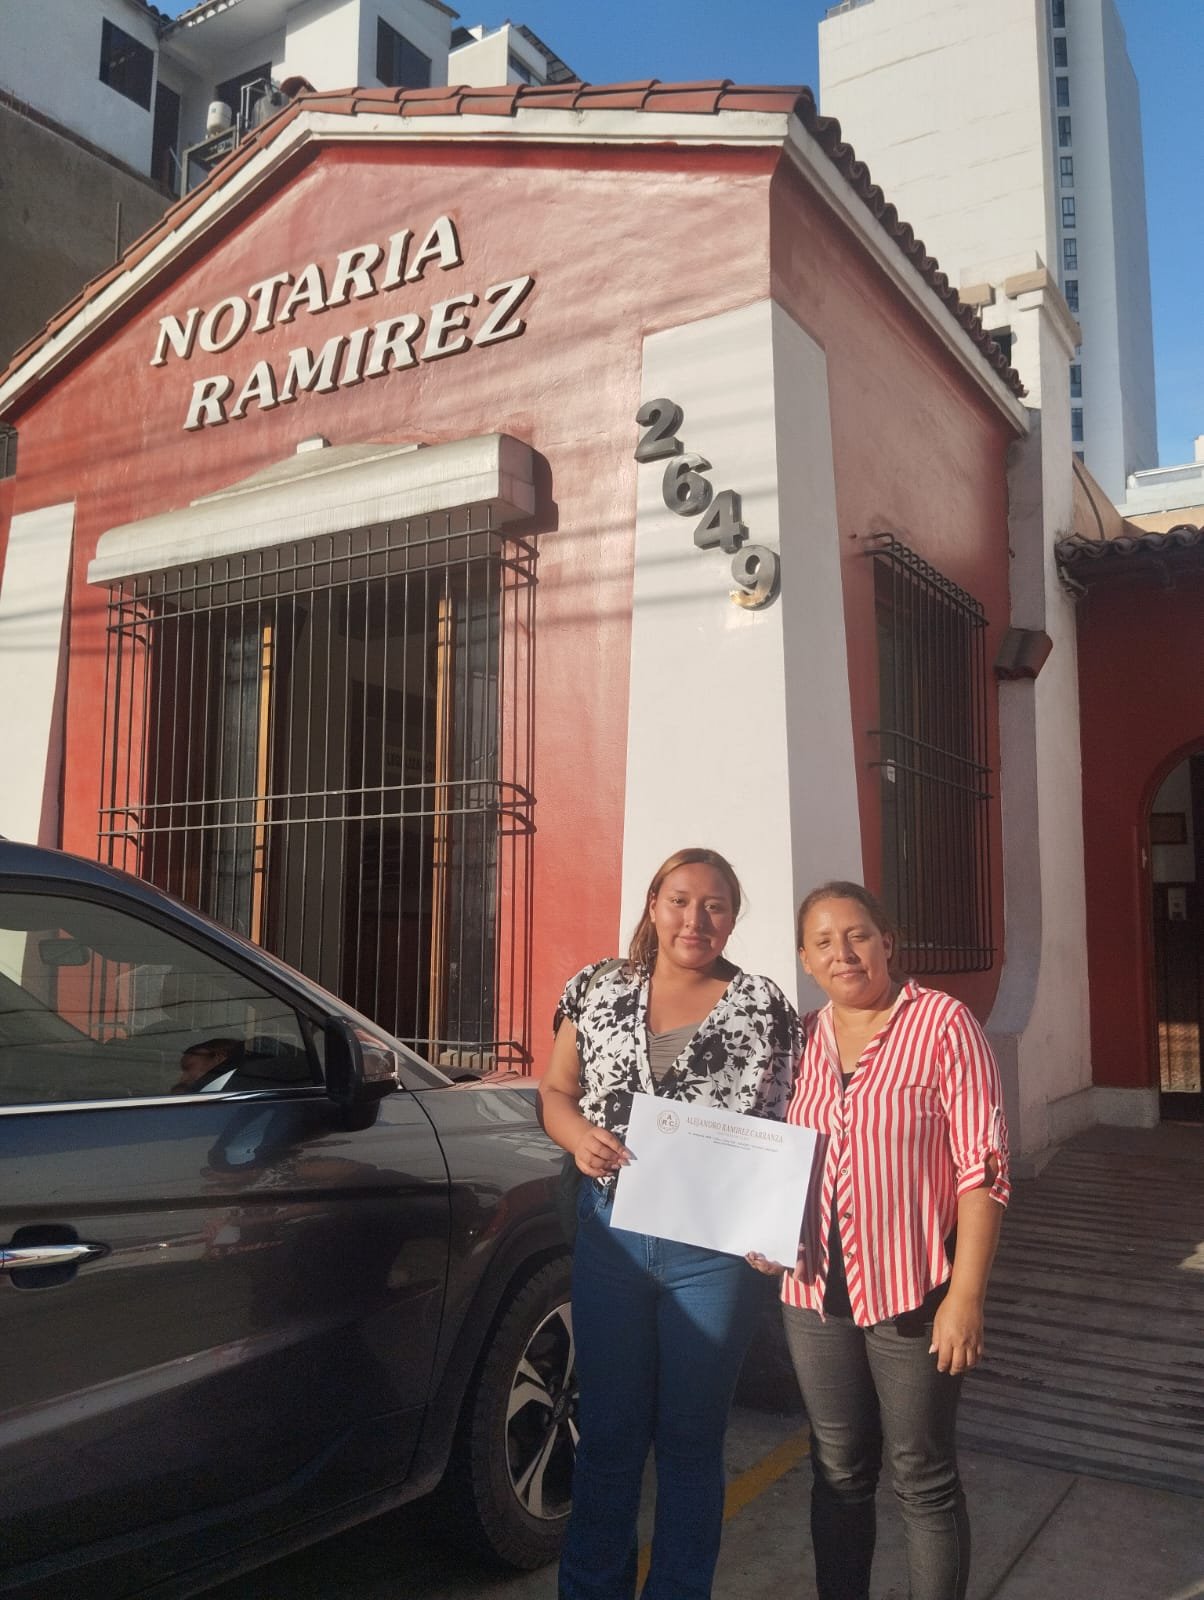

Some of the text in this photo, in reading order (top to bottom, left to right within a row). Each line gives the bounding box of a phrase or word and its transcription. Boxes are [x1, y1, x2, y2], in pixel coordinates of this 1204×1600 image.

[150, 216, 463, 367] NOTARIA
[183, 275, 535, 432] RAMIREZ
[635, 398, 781, 611] 2649
[687, 1116, 721, 1130] ALEJANDRO
[722, 1123, 750, 1136] RAMIREZ
[750, 1129, 783, 1143] CARRANZA
